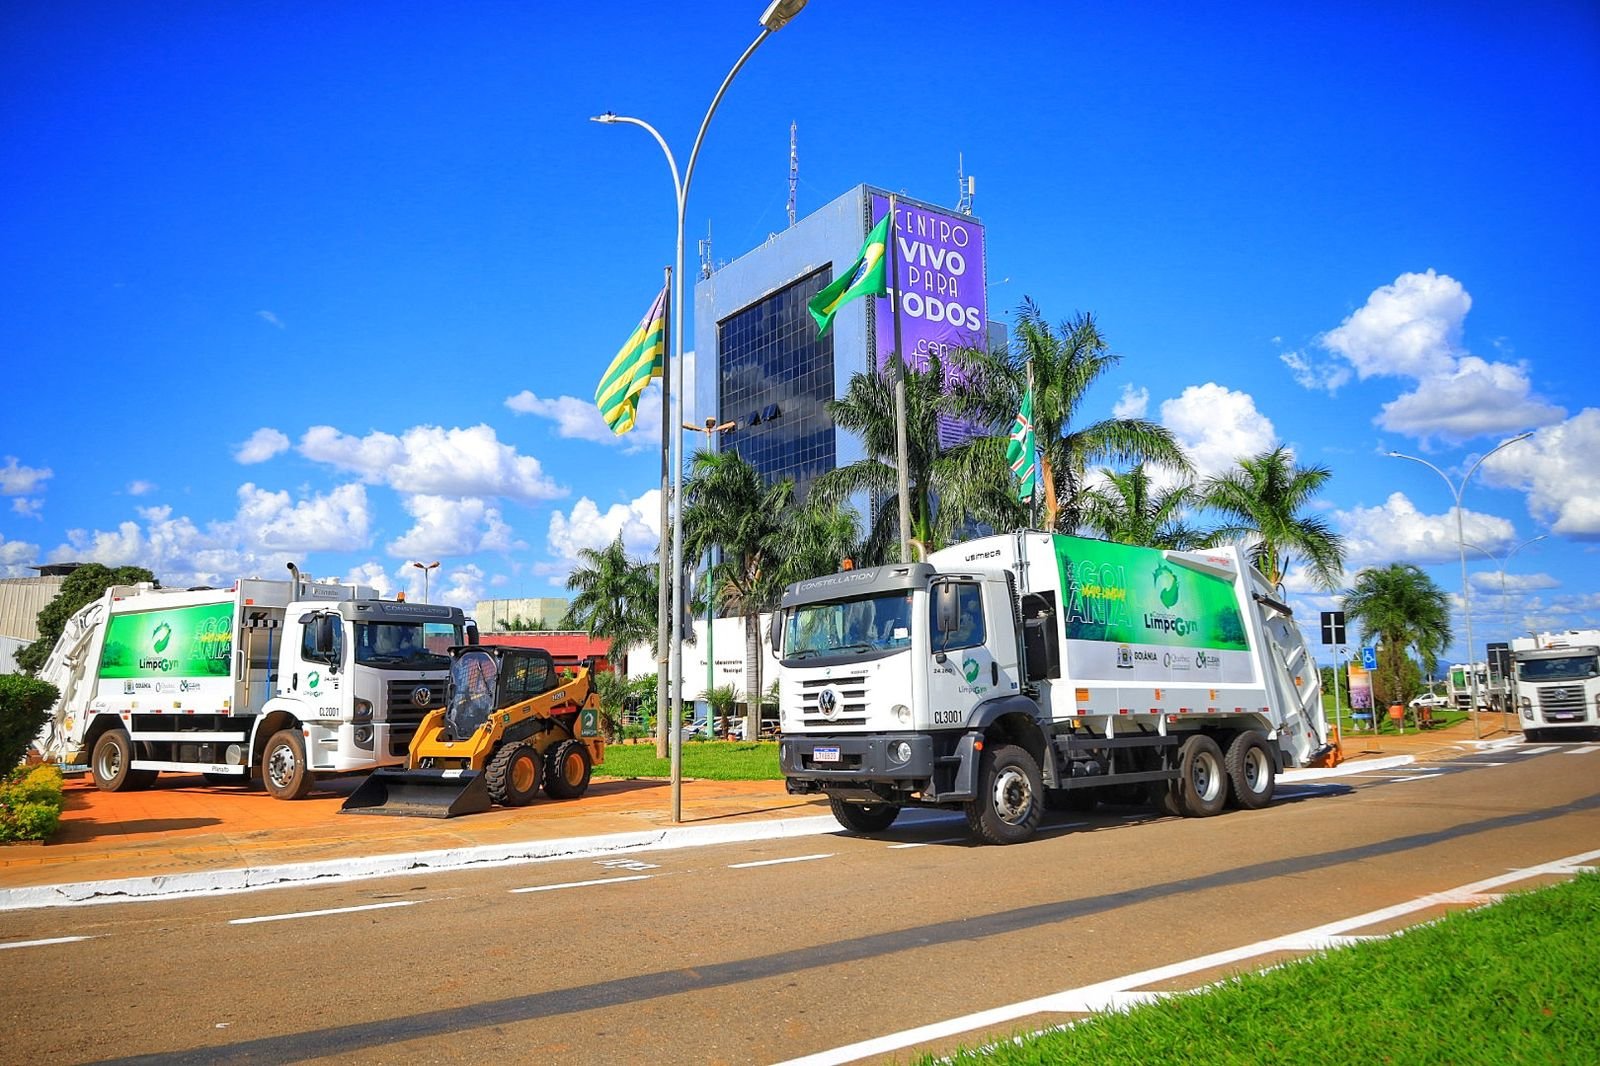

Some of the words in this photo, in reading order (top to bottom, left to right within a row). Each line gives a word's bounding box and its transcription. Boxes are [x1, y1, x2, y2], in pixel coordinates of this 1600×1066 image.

[895, 209, 969, 248] CENTRO
[898, 237, 966, 276] VIVO
[908, 265, 959, 298] PARA
[886, 287, 981, 331] TODOS
[801, 571, 874, 592] CONSTELLATION
[385, 604, 449, 616] CONSTELLATION
[934, 710, 963, 724] CL3001
